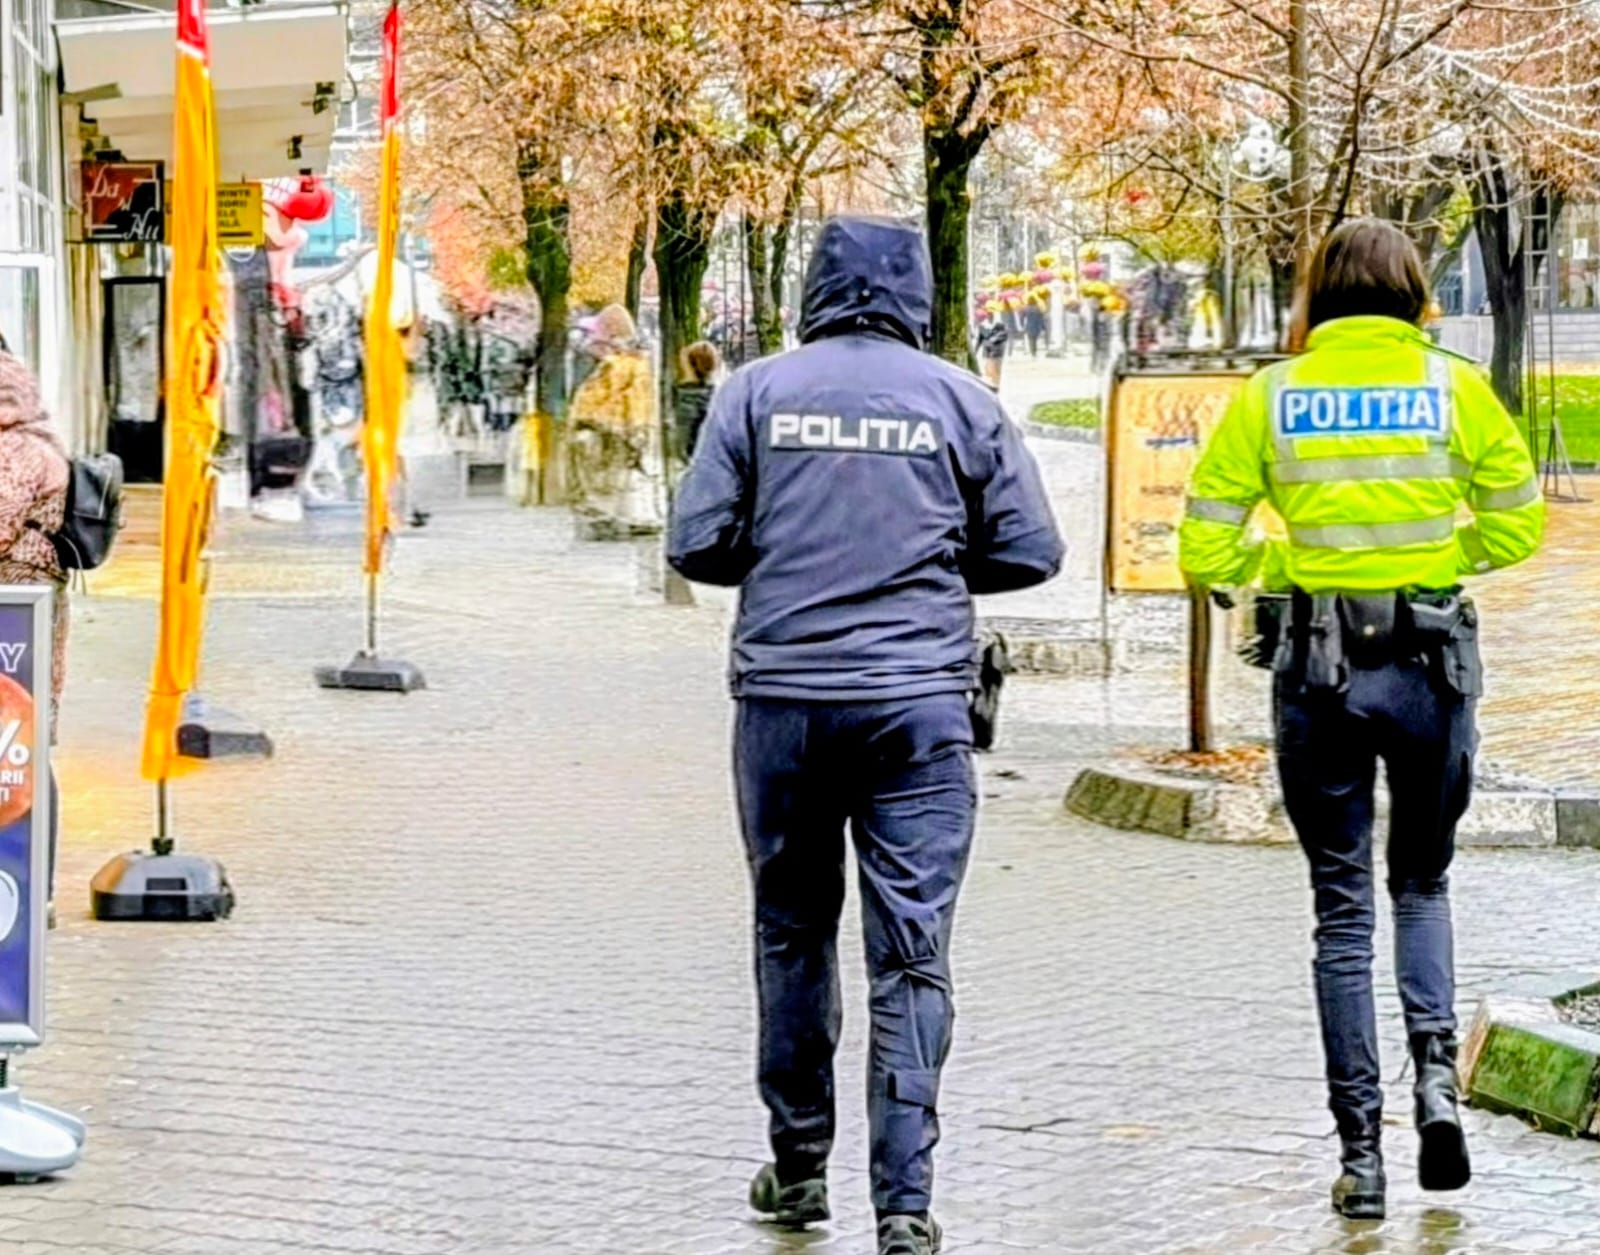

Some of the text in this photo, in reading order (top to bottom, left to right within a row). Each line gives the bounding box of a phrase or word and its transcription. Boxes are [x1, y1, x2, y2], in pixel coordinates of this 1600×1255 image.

[1286, 391, 1436, 430] POLITIA
[770, 414, 938, 452] POLITIA
[0, 642, 27, 673] Y
[1, 769, 24, 785] RII
